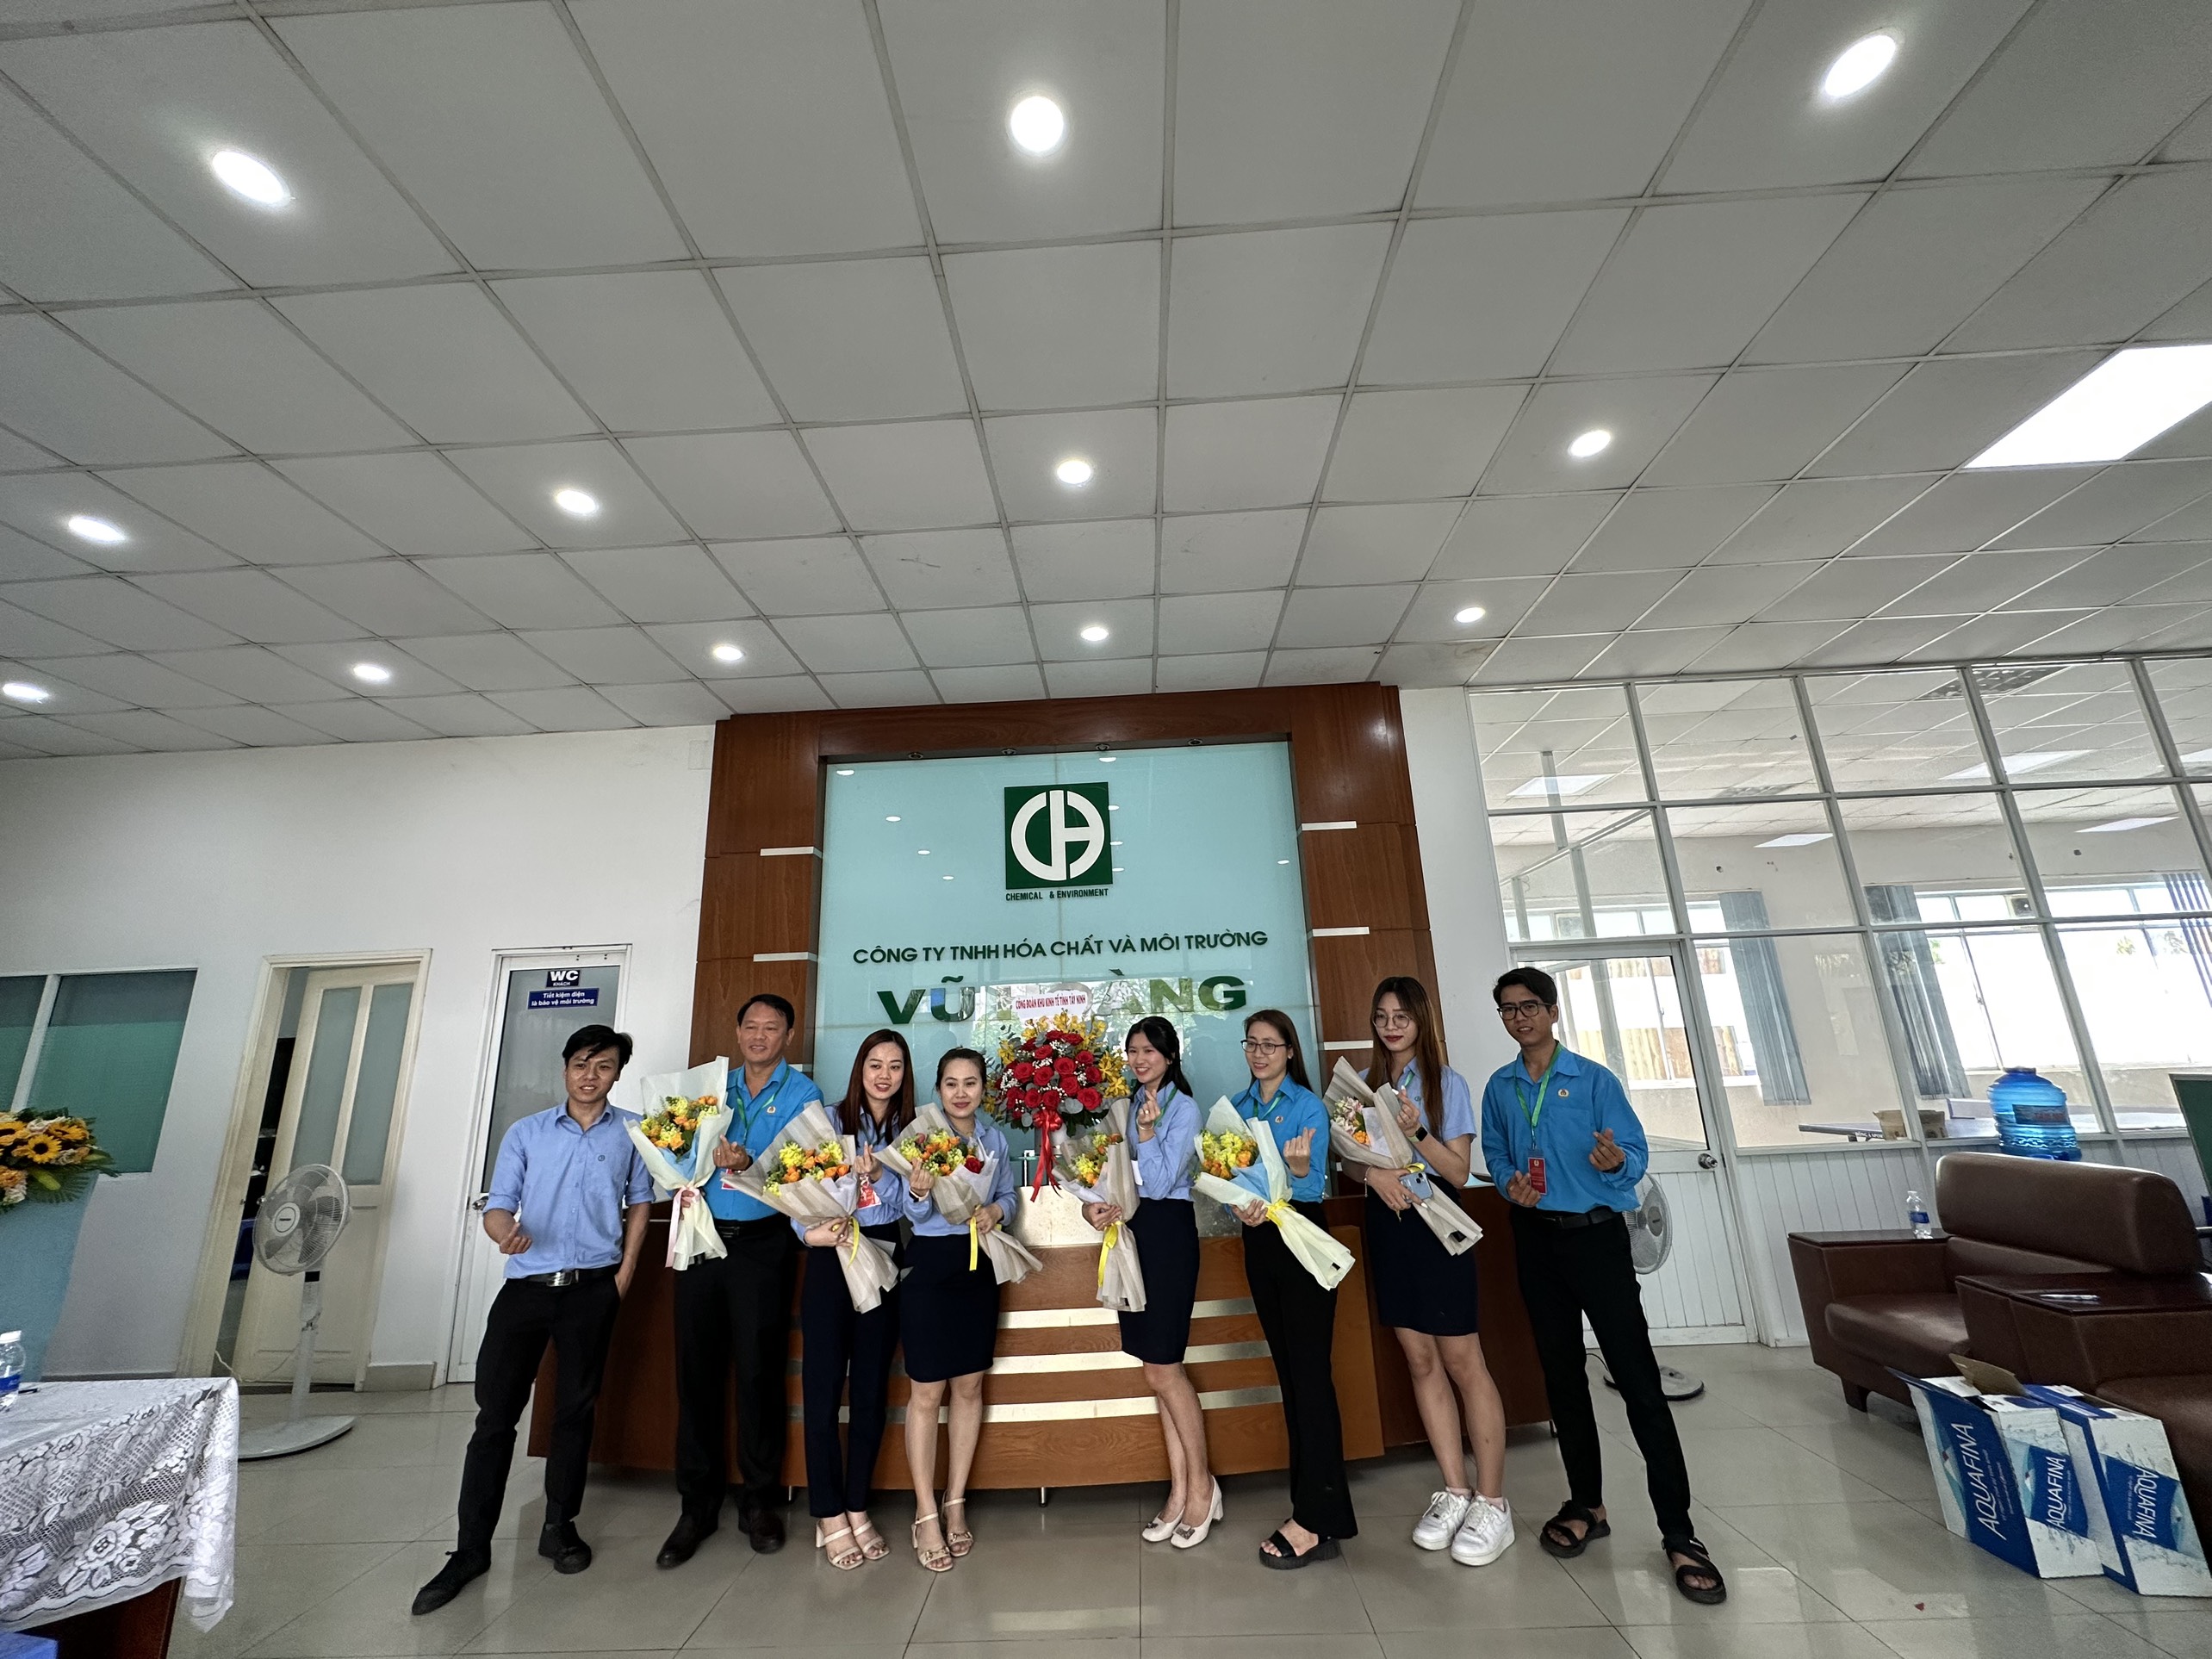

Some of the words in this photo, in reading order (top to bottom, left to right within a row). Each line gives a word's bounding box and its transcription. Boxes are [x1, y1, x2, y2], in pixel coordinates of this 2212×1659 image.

[1006, 892, 1043, 901] CHEMICAL
[1057, 888, 1109, 898] ENVIRONMENT
[853, 945, 917, 964] CÔNG
[923, 947, 945, 961] TY
[950, 944, 999, 960] TNHH
[1003, 938, 1047, 958] HÓA
[1050, 934, 1103, 955] CHẤT
[1108, 935, 1136, 953] VÀ
[1140, 933, 1180, 952] MÔI
[1184, 929, 1268, 949] TRƯỜNG
[550, 971, 578, 981] WC
[877, 975, 976, 1024] VŨ
[1951, 1423, 2007, 1540] AQUAFINA
[2046, 1457, 2066, 1530] AQUAFINA
[2132, 1466, 2159, 1538] AQUAFINA
